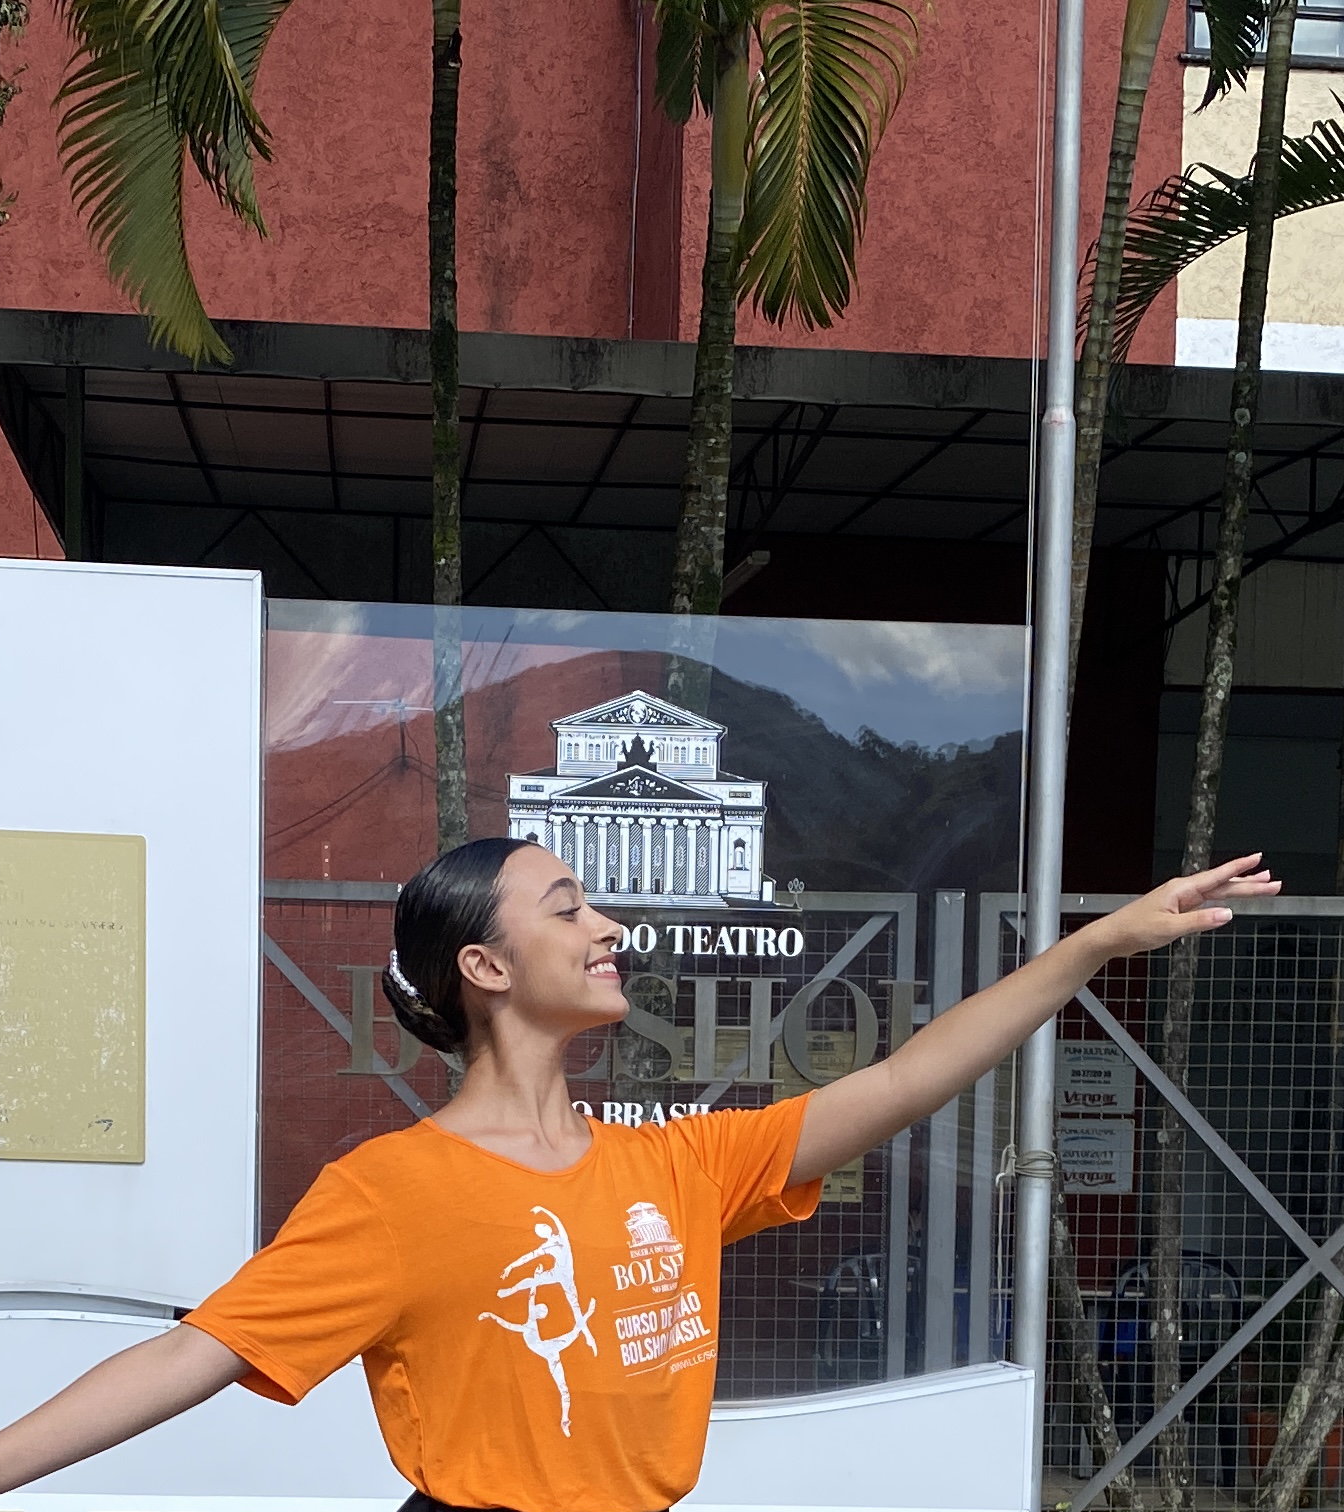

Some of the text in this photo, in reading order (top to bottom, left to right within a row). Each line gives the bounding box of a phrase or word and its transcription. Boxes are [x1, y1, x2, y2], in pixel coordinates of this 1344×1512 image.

[666, 926, 804, 957] TEATRO
[337, 965, 929, 1086] BSHOI
[610, 1251, 685, 1291] BOLSH
[615, 1310, 658, 1340] CURSO
